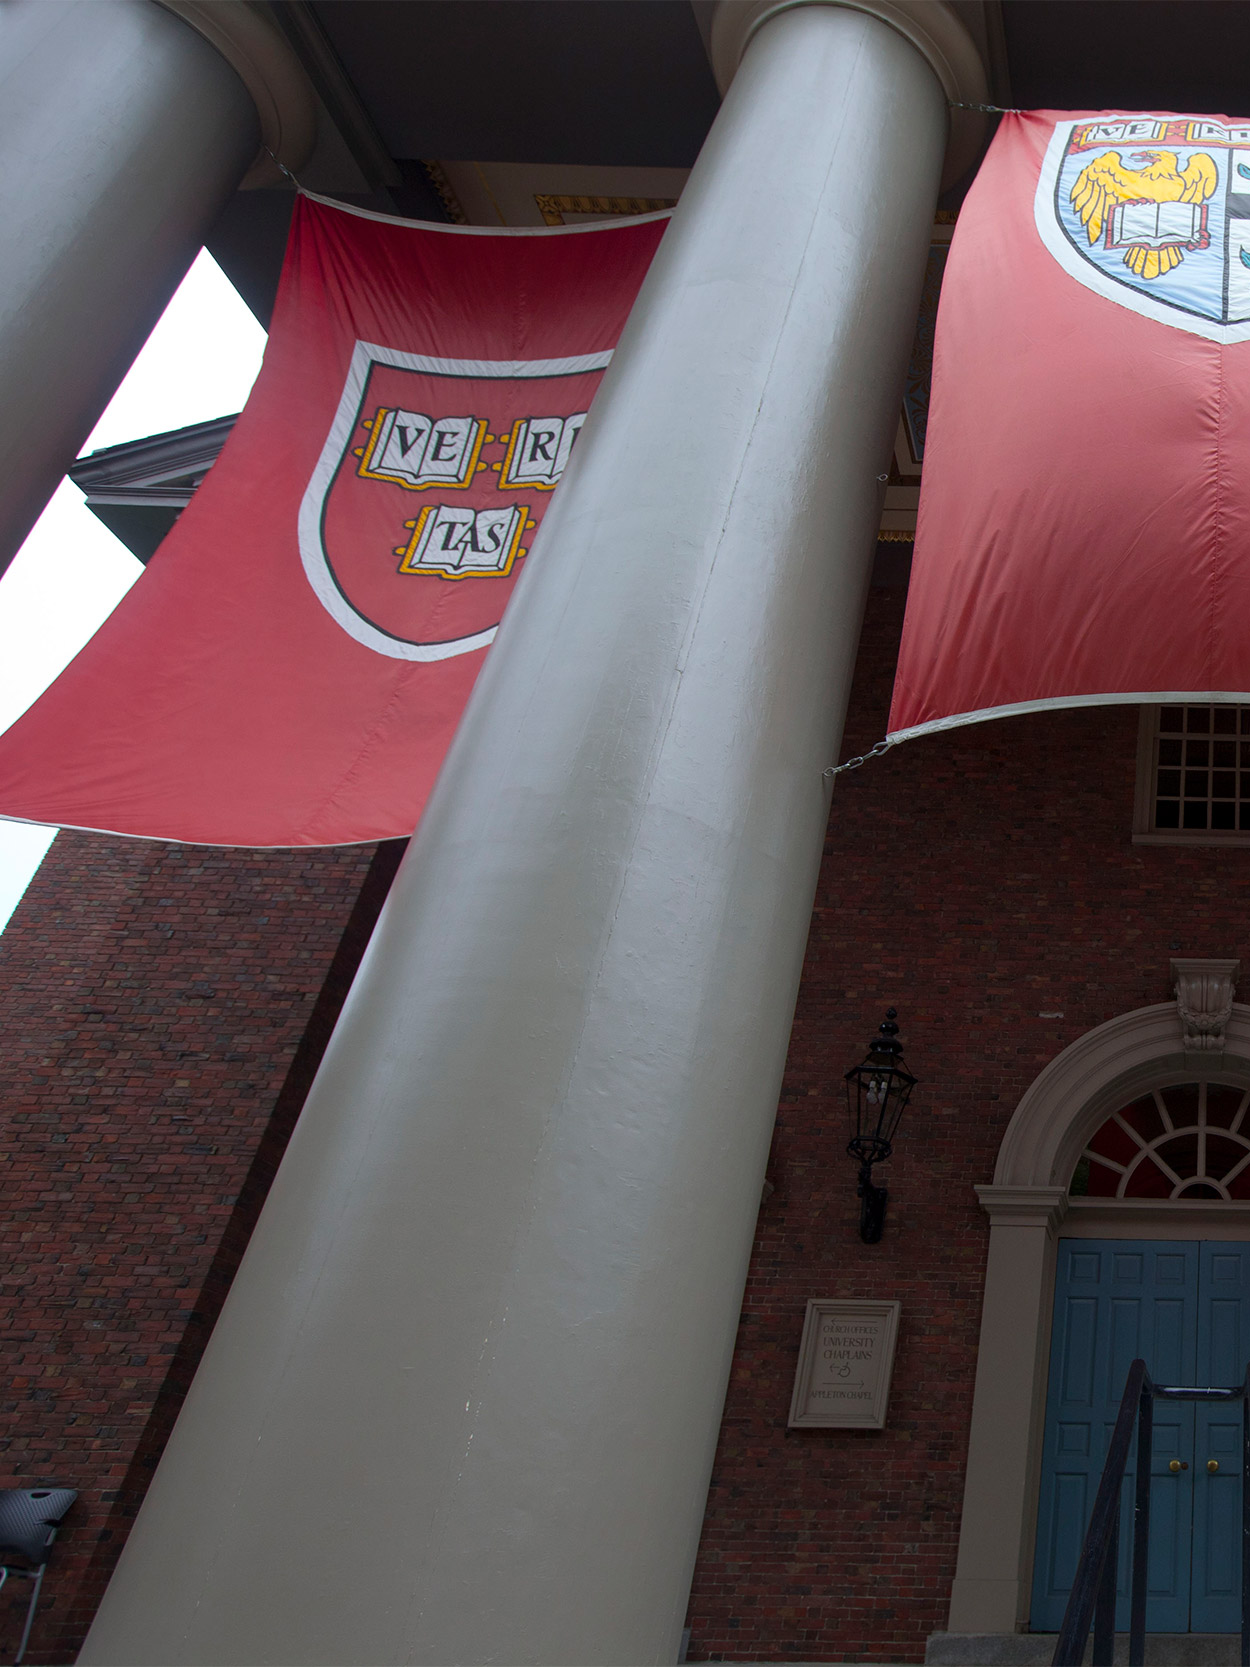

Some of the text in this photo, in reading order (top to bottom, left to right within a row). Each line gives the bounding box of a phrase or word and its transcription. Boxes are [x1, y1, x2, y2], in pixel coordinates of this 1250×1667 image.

[1099, 121, 1155, 136] VE
[395, 424, 460, 462] VE
[435, 520, 506, 553] TAS
[823, 1325, 878, 1335] CHURCH OFFICES
[823, 1337, 876, 1348] UNIVERSITY
[823, 1350, 873, 1360] CHAPLAINS
[811, 1390, 873, 1400] APPLETON CHAPEL
